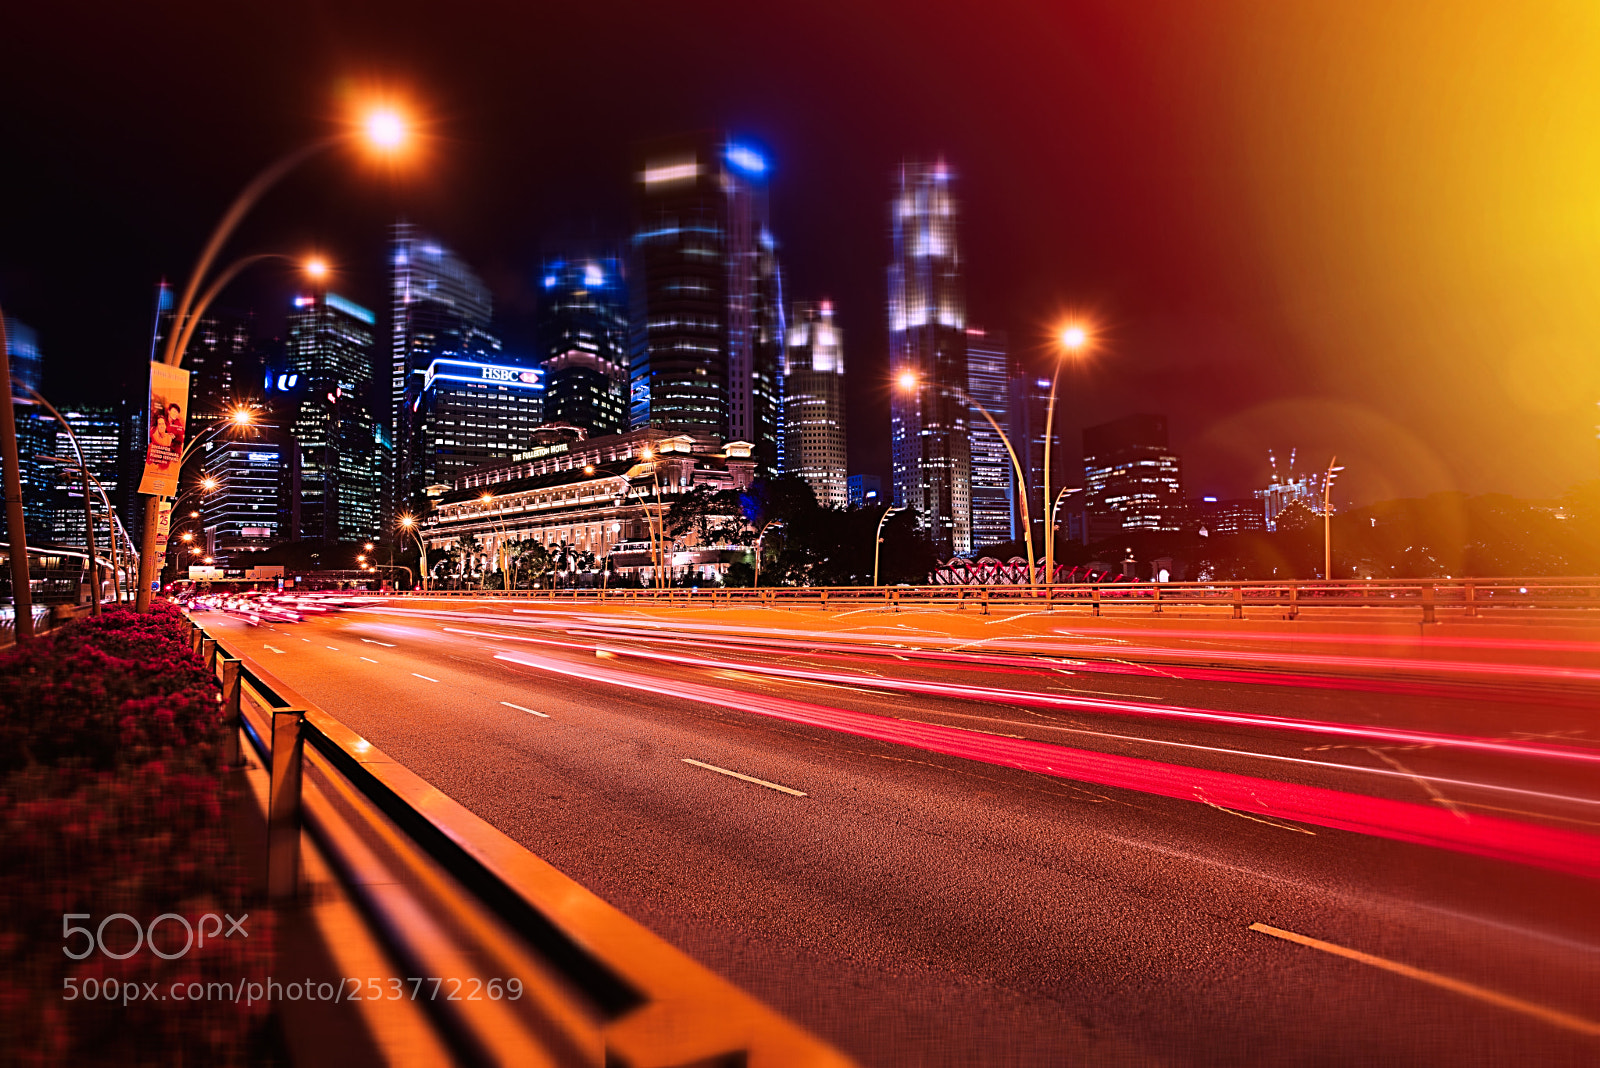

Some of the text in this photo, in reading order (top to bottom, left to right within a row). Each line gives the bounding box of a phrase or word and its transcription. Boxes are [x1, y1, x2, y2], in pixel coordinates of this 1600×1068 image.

[482, 367, 519, 381] HSBC
[512, 453, 522, 462] THE
[550, 443, 568, 454] HOTEL
[159, 515, 169, 526] 25
